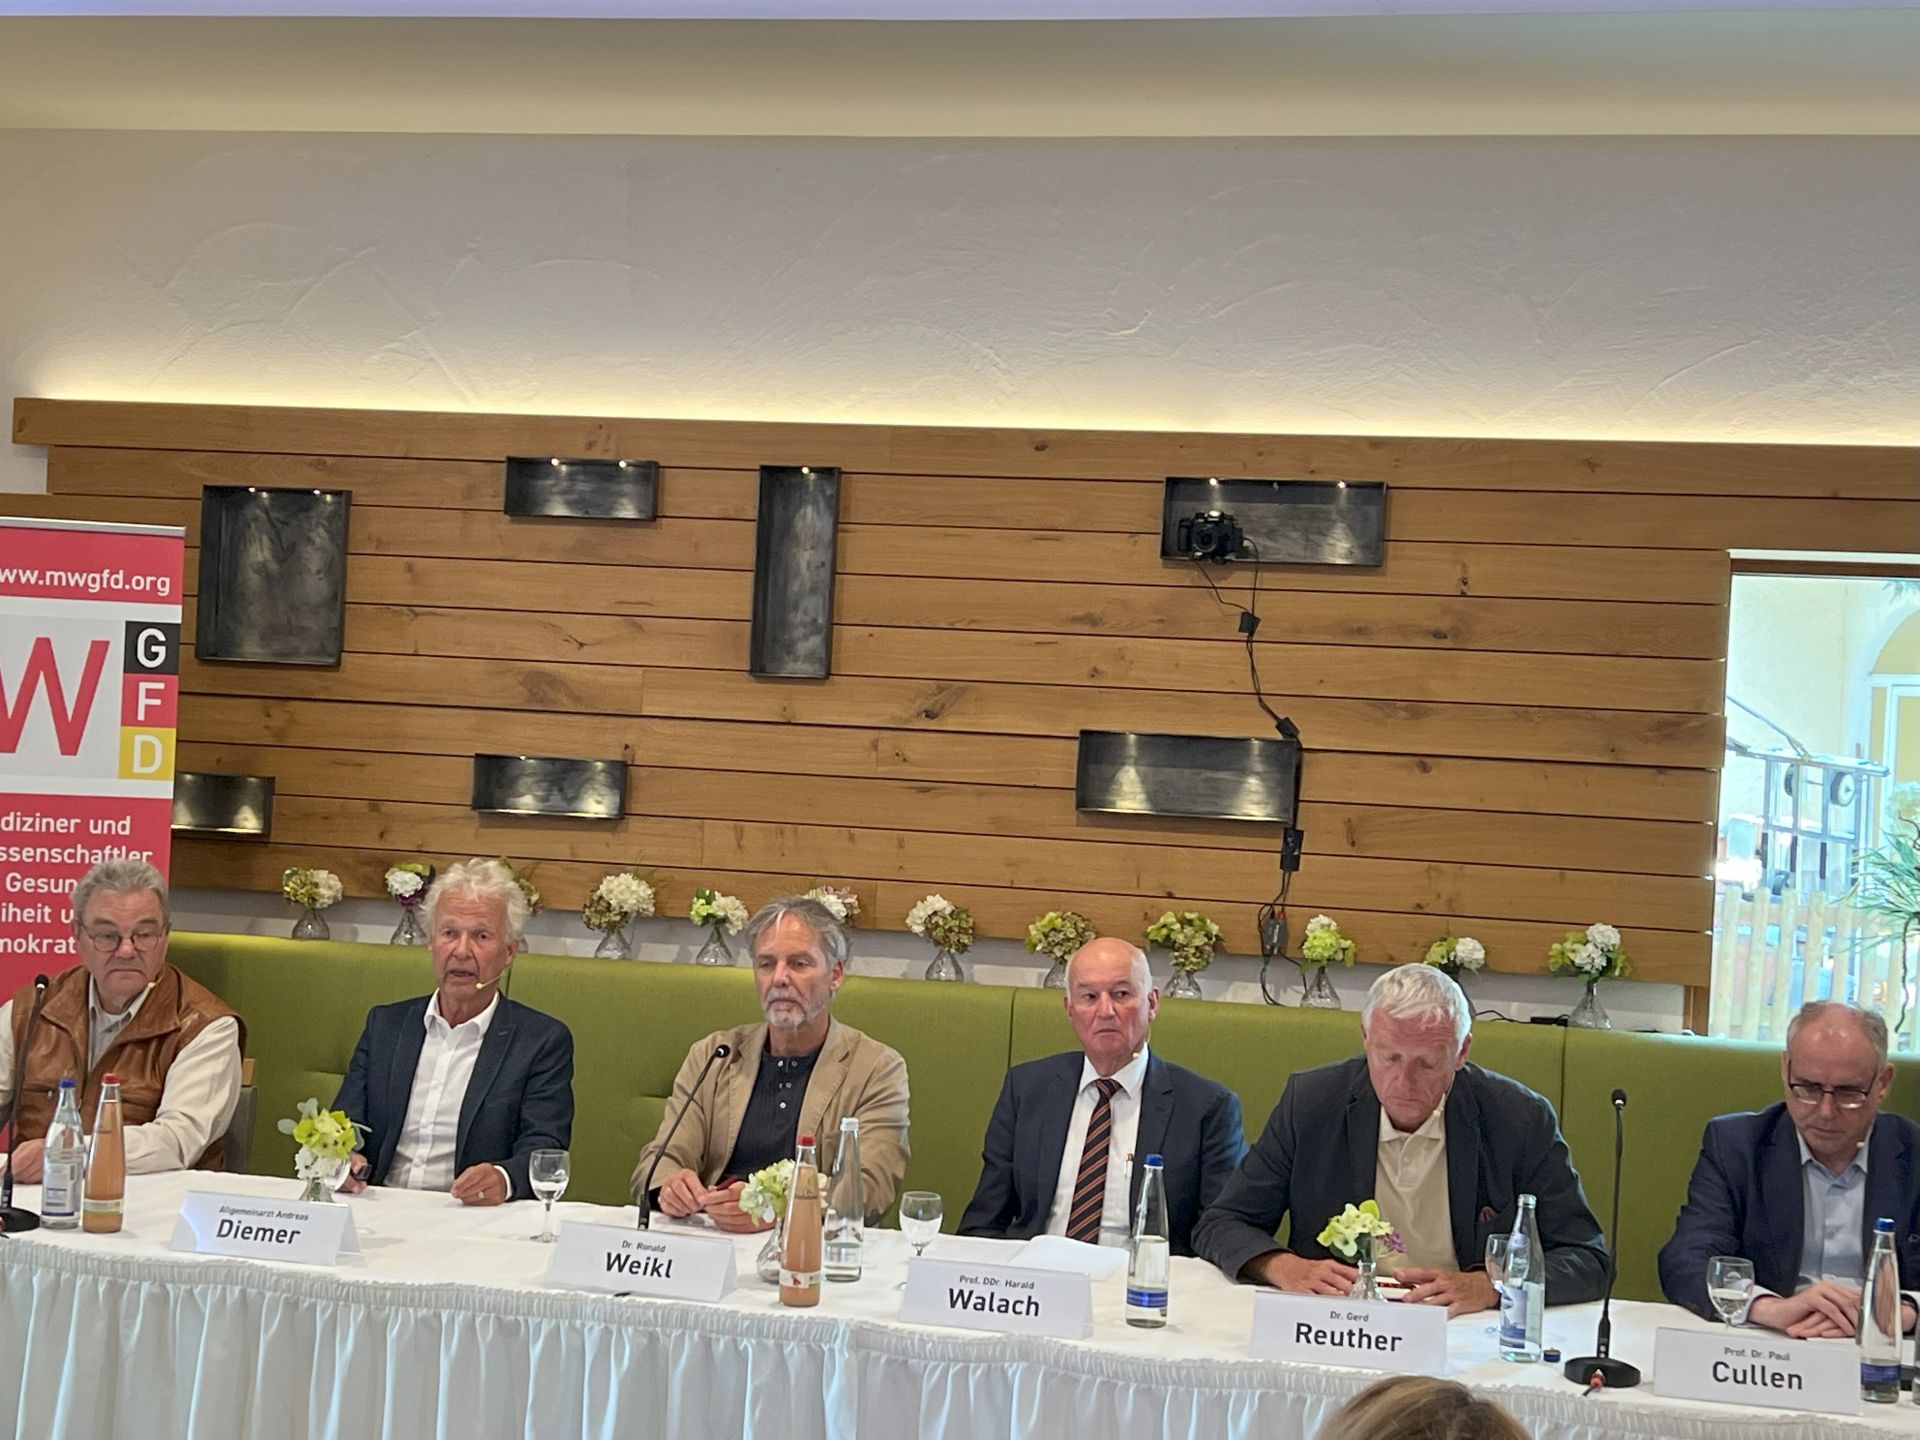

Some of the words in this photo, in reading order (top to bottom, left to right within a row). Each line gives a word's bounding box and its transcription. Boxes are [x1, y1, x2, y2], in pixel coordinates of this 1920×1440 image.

[0, 811, 81, 833] diziner
[89, 815, 131, 836] und
[1, 902, 52, 924] iheit
[275, 1210, 309, 1221] Andreas
[216, 1218, 301, 1244] Diemer
[636, 1242, 667, 1253] Ronald
[606, 1252, 673, 1279] Weikl
[1005, 1279, 1035, 1290] Harald
[948, 1287, 1040, 1317] Walach
[1346, 1312, 1369, 1322] Gerd
[1295, 1322, 1403, 1352] Reuther
[1768, 1351, 1791, 1362] Paul
[1712, 1360, 1803, 1391] Cullen
